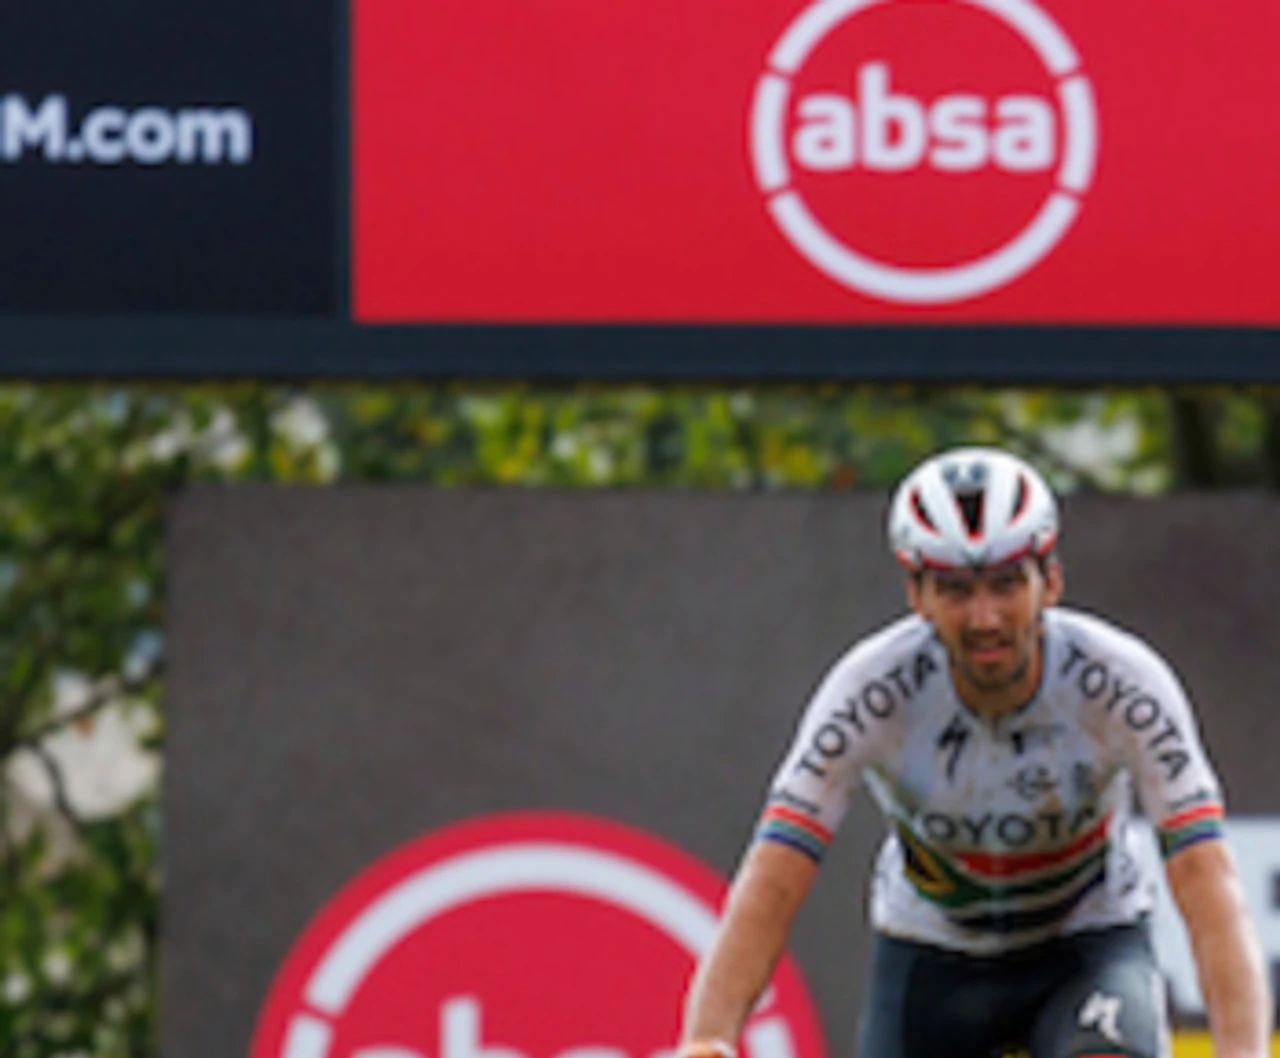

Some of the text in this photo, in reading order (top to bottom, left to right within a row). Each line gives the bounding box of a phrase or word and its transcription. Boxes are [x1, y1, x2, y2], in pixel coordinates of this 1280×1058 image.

[0, 95, 250, 163] M.com
[794, 62, 1057, 170] absa
[795, 652, 940, 780] TOYOTA
[1059, 645, 1192, 781] TOYOTA
